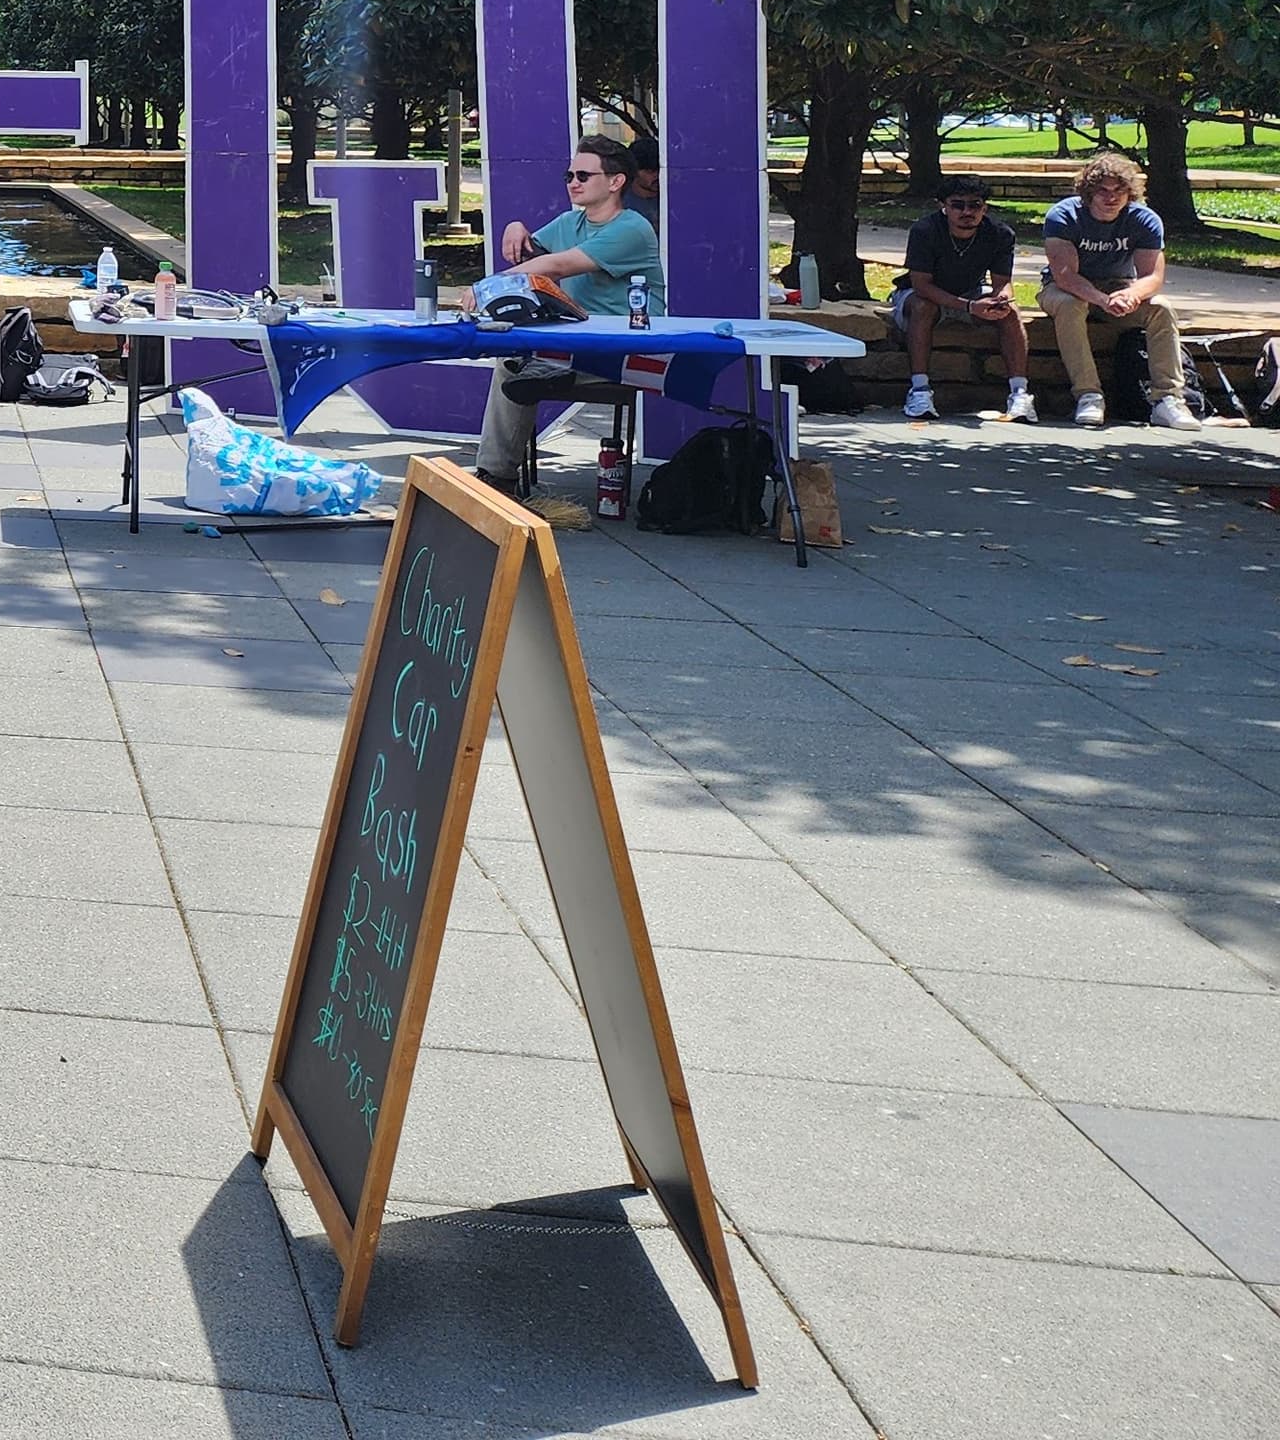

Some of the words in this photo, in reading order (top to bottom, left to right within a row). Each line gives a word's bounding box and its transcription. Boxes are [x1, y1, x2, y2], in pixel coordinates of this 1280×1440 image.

[1079, 238, 1115, 252] Hurley
[400, 546, 474, 699] Charity
[392, 659, 438, 772] Car
[360, 752, 417, 894] Bash
